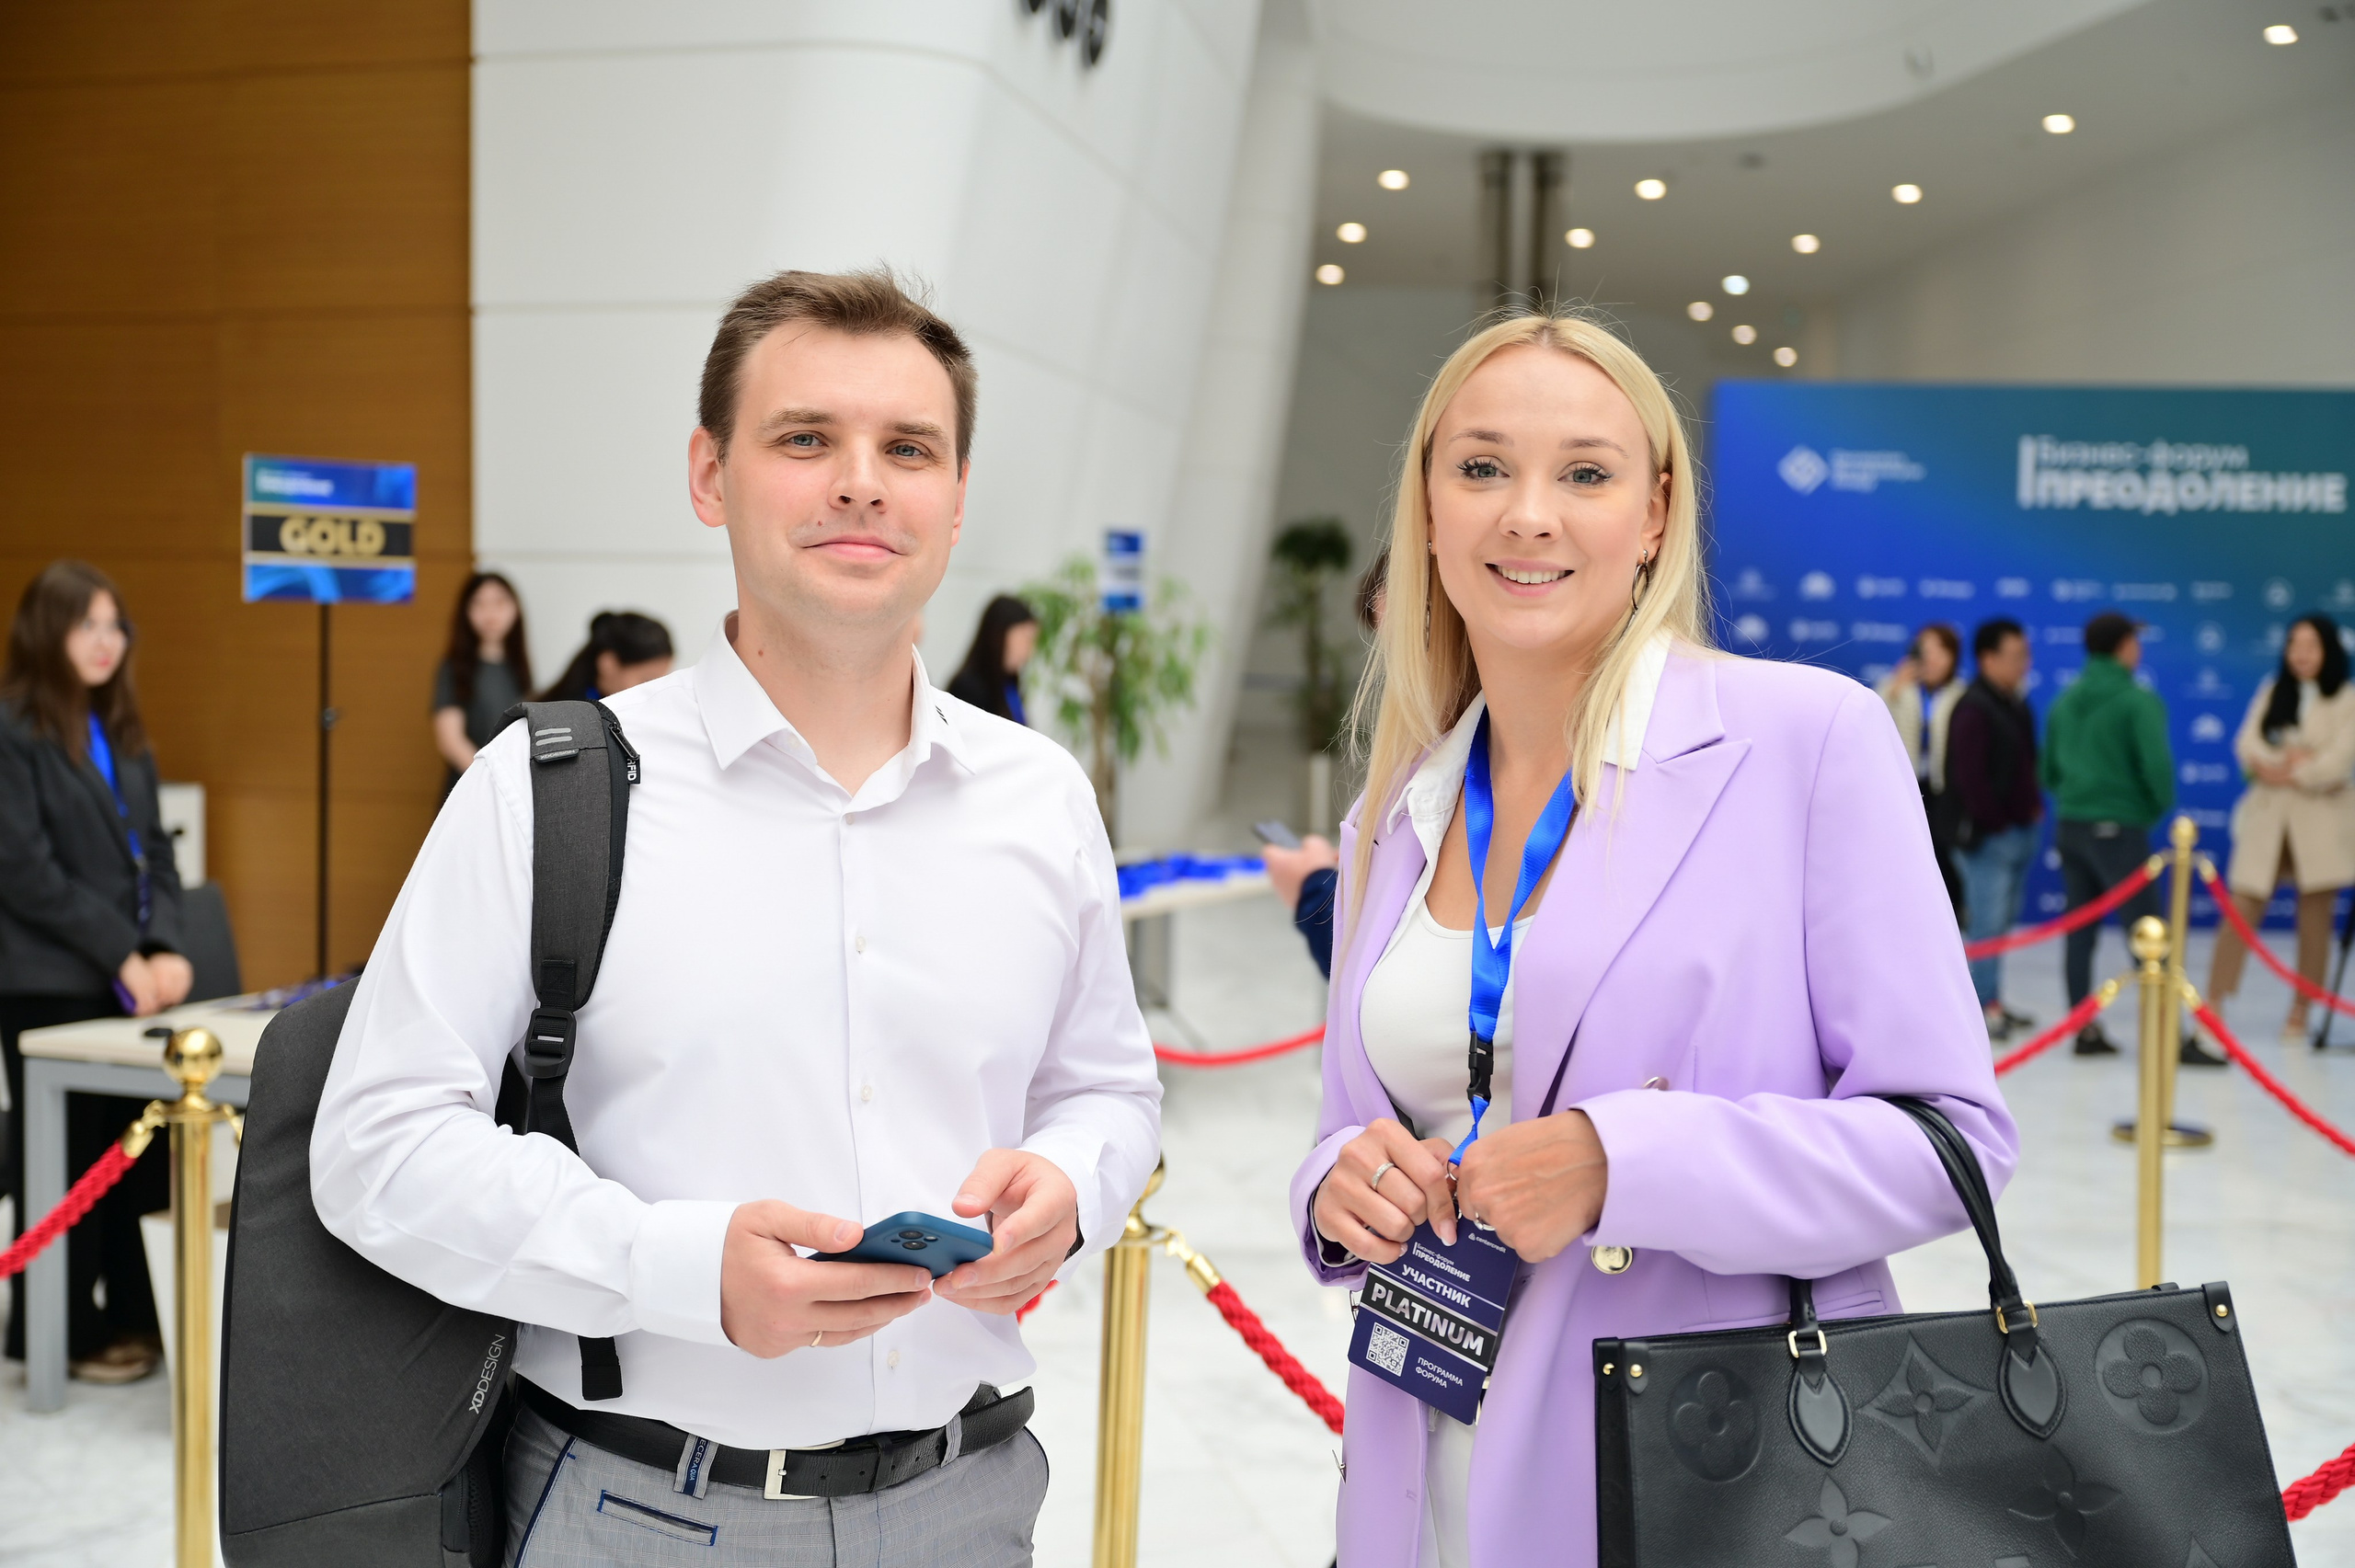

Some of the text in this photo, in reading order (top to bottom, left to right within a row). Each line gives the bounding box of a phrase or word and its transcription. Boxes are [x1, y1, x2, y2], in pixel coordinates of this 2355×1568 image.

[2036, 469, 2347, 516] ПРЕОДОЛЕНИЕ
[279, 515, 386, 556] GOLD
[1402, 1264, 1471, 1308] УЧАСТНИК
[1415, 1249, 1471, 1282] ПРЕОДОЛЕНИЕ
[1371, 1282, 1485, 1356] PLATINUM
[1415, 1366, 1447, 1389] ФОРУМА
[1418, 1356, 1463, 1386] ПРОГРАММА
